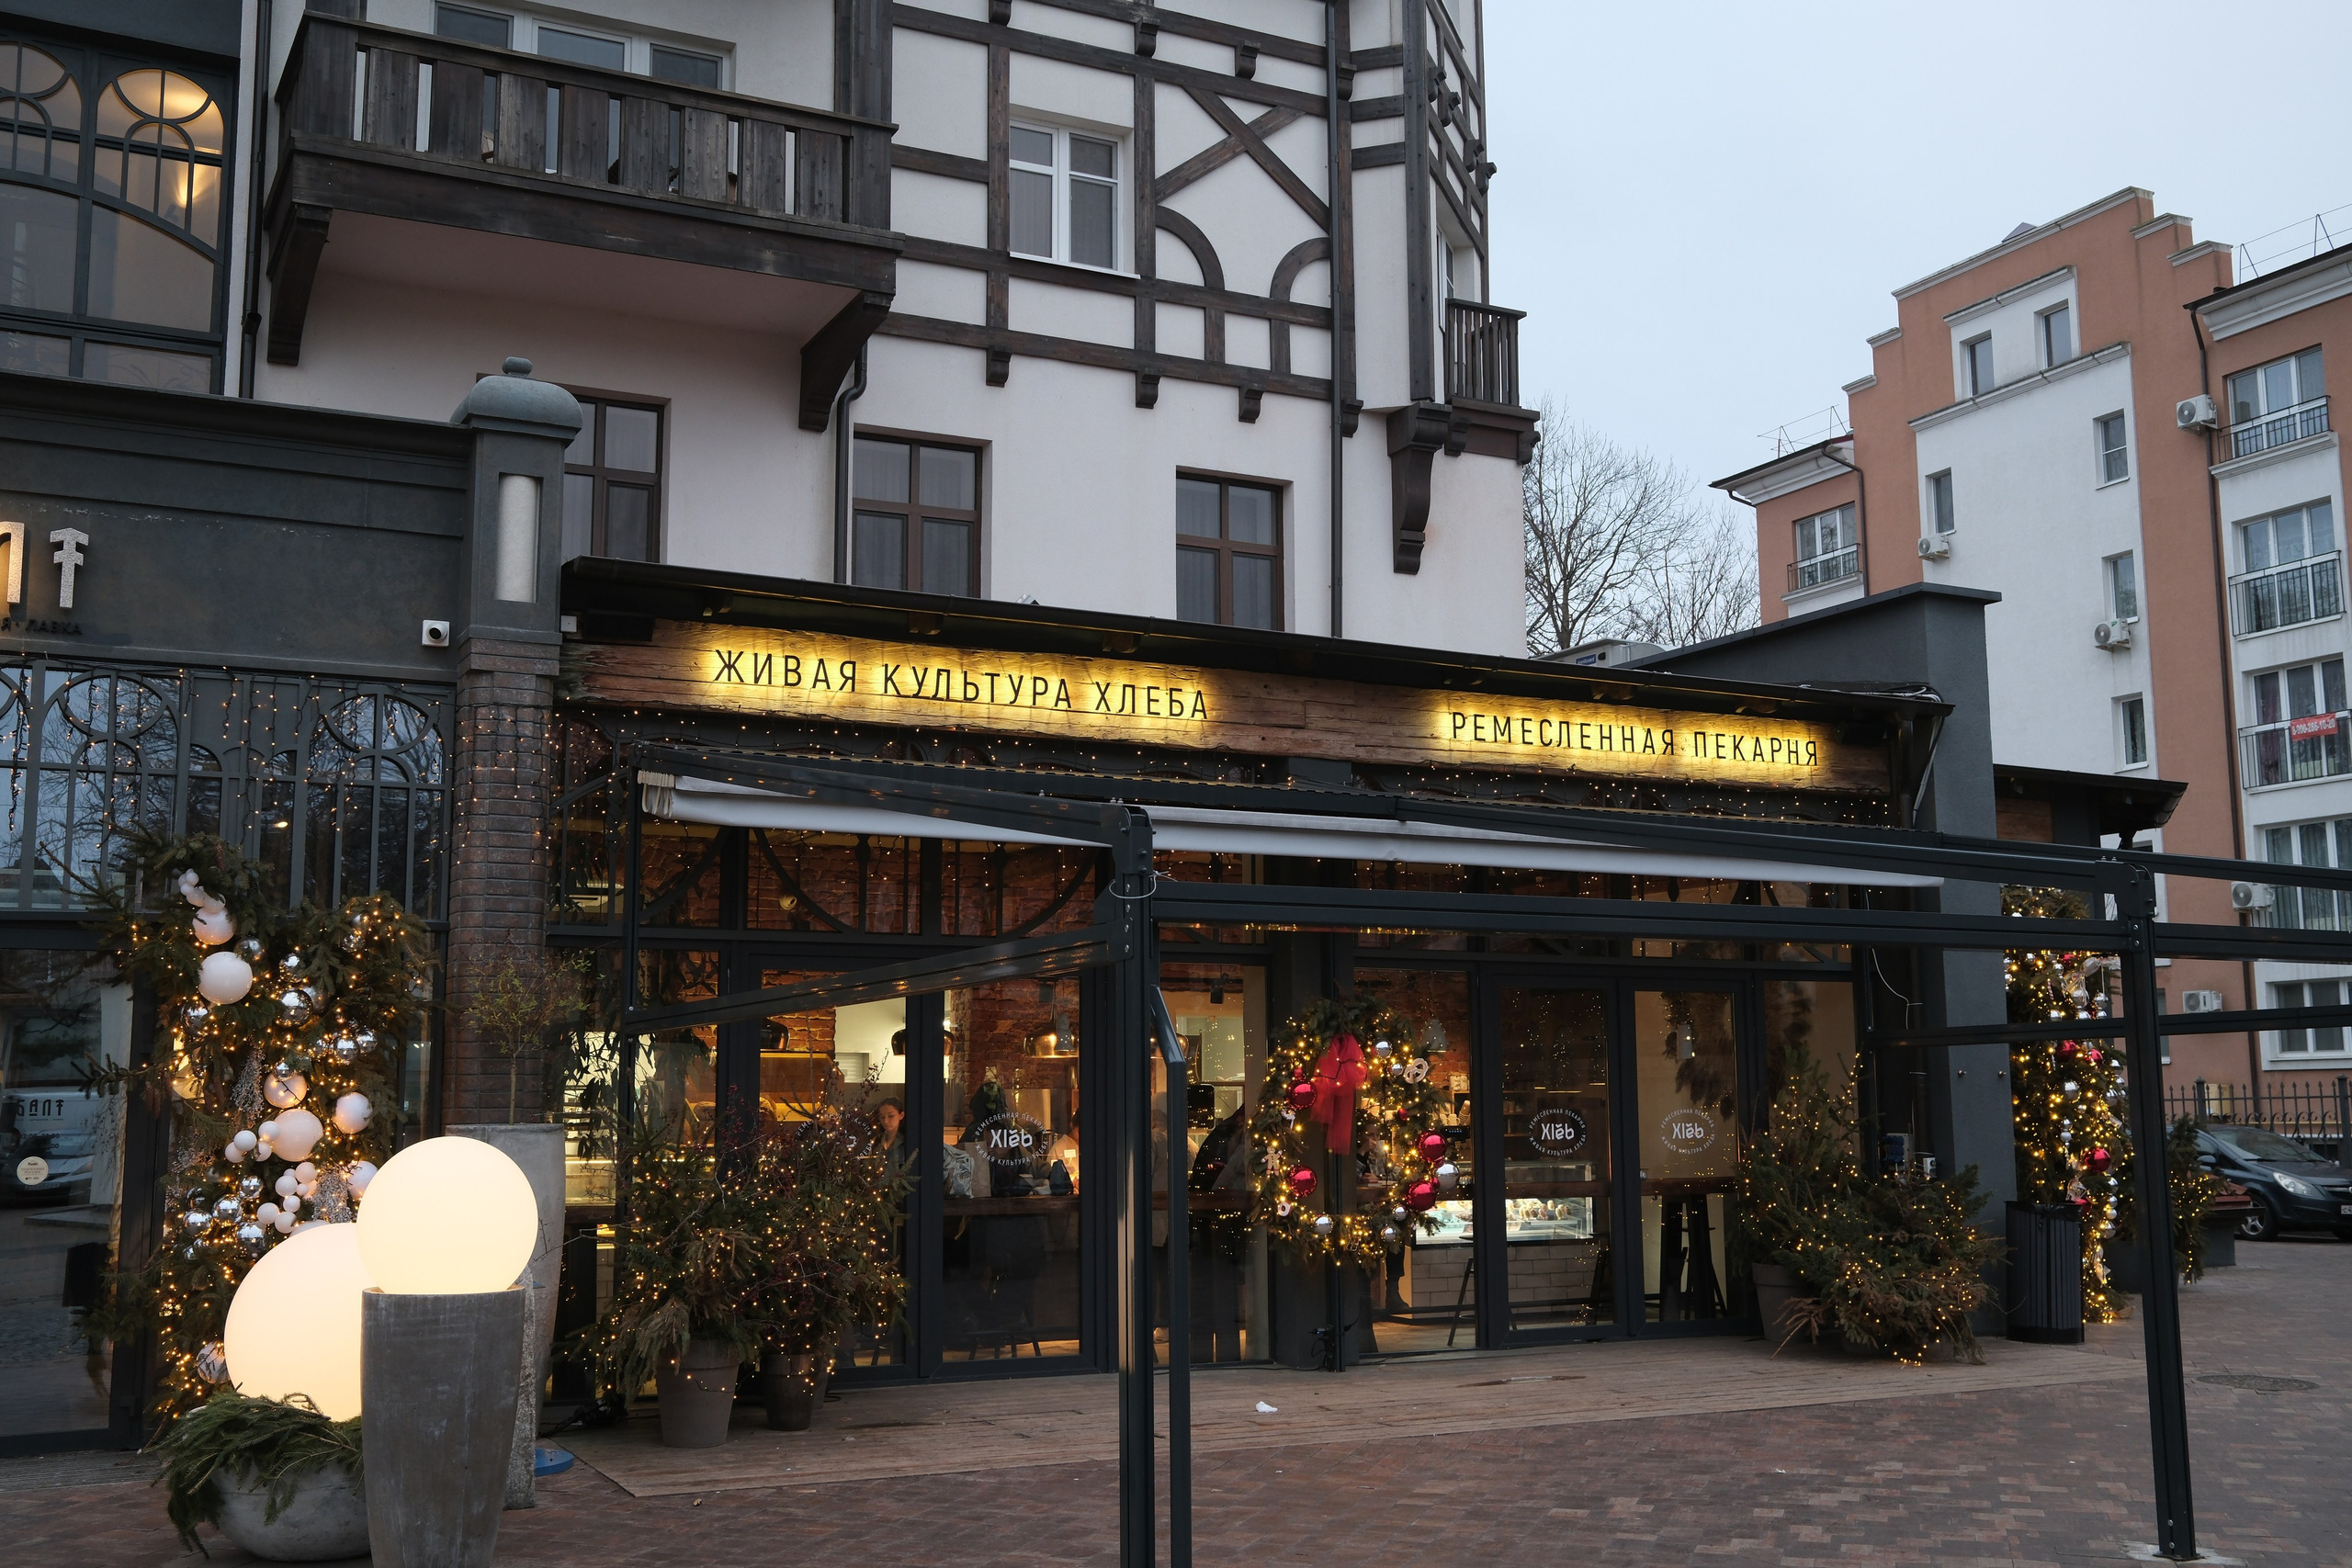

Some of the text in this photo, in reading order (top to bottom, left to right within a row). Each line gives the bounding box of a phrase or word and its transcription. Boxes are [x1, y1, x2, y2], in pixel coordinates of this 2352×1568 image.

[25, 618, 83, 636] ЛАВКА
[713, 649, 1208, 719] ЖИВАЯ КУЛЬТУРА ХЛЕБА
[1452, 712, 1818, 766] РЕМЕСЛЕННАЯ ПЕКАРНЯ
[975, 1111, 1047, 1136] РЕМЕСЛЕННАЯ ПЕКАРНЯ
[1529, 1108, 1586, 1129] РЕМЕСЛЕННАЯ ПЕКАРНЯ
[1660, 1108, 1692, 1128] РЕМЕСЛЕННАЯ
[975, 1140, 1048, 1166] ЖИВАЯ КУЛЬТУРА ХЛЕБА
[1529, 1136, 1545, 1153] ЖИВАЯ
[1573, 1134, 1586, 1150] ХЛЕБА
